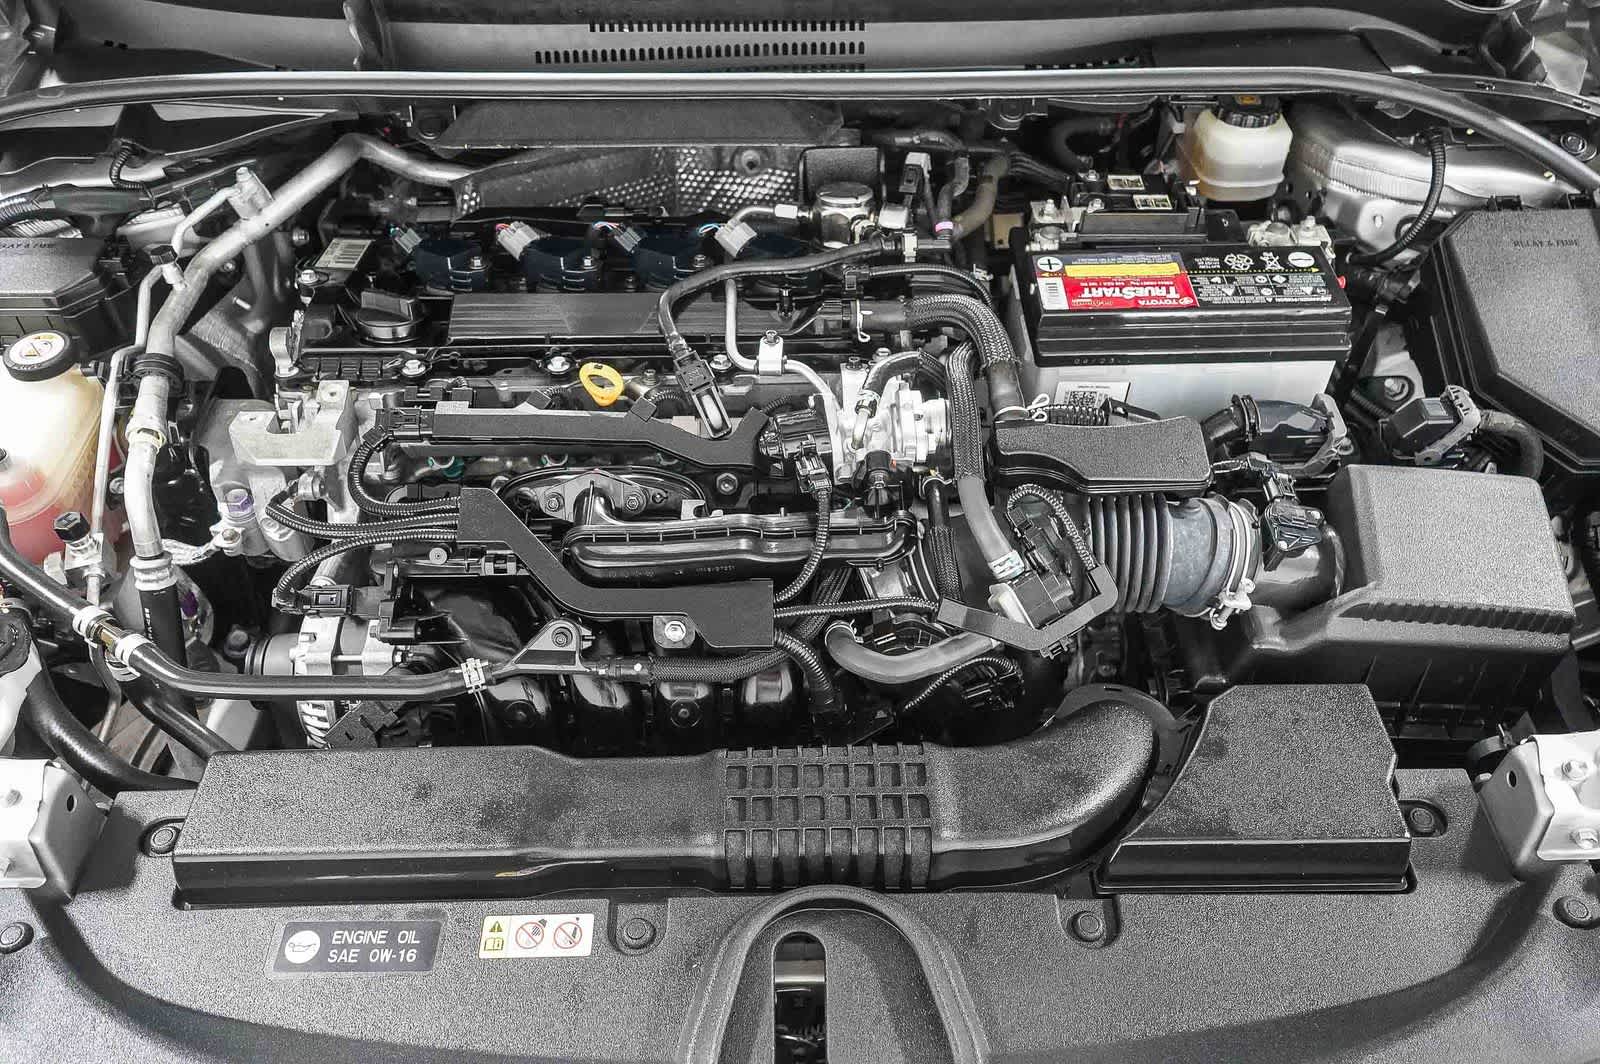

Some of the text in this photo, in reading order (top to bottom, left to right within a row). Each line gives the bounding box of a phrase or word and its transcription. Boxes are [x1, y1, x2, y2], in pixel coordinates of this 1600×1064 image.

[332, 930, 421, 945] ENGINE OIL
[327, 949, 417, 963] SAE 0W-16
